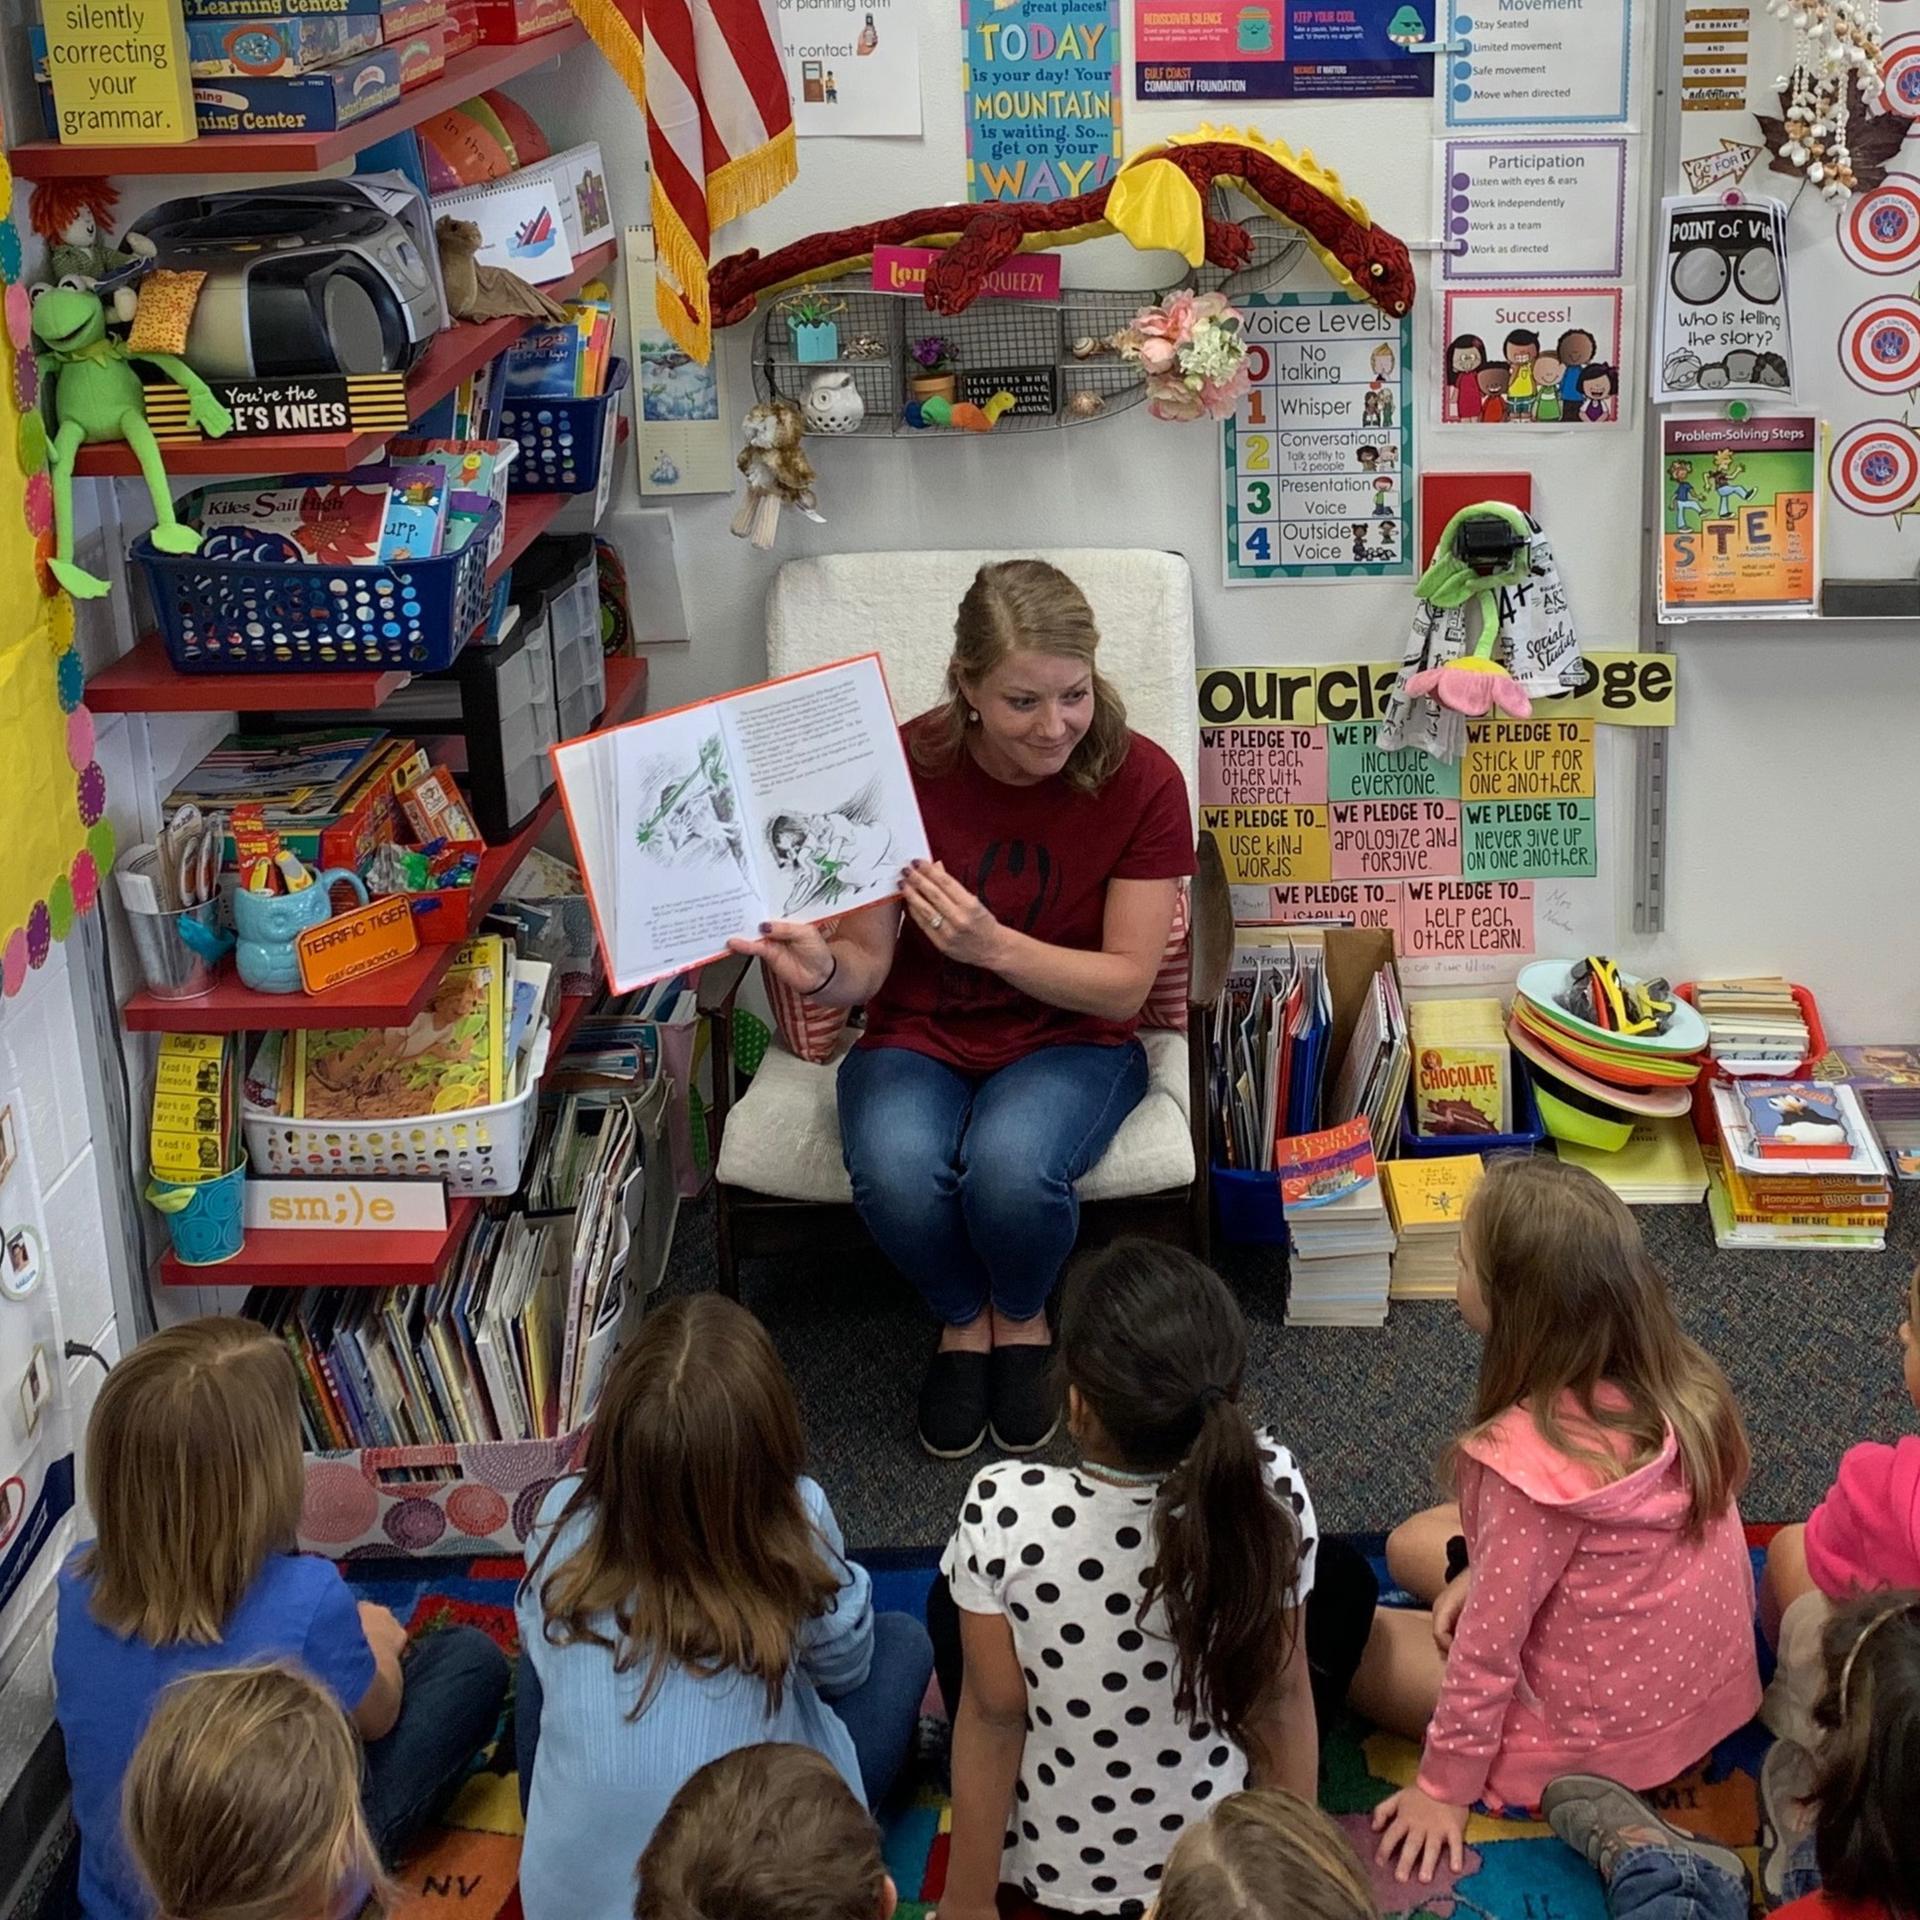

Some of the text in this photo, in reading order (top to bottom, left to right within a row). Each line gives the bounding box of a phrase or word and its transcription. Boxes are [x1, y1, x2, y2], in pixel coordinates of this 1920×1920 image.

[288, 0, 348, 12] Center
[1022, 1, 1057, 17] great
[1499, 0, 1583, 11] Movement
[66, 4, 144, 33] silently
[1474, 19, 1529, 31] Stay Seated
[1709, 21, 1738, 29] BRAVE
[799, 44, 853, 57] contact
[976, 23, 1107, 62] TODAY
[1474, 42, 1562, 52] Limited movement
[53, 38, 168, 69] correcting
[973, 68, 1112, 87] is your day! Your
[1144, 67, 1191, 79] GULF COAST
[1473, 65, 1546, 75] Safe movement
[89, 73, 136, 101] your
[1144, 80, 1246, 92] COMMUNITY FOUNDATION
[1474, 88, 1571, 100] Move when directed
[974, 90, 1111, 120] MOUNTAIN
[63, 107, 170, 135] grammar.
[243, 113, 306, 129] Center
[980, 123, 1108, 143] is waiting. So...
[462, 135, 487, 163] the
[991, 142, 1098, 160] get on your
[1488, 154, 1585, 170] Participation
[1692, 147, 1751, 185] Go FOR IT
[1471, 176, 1577, 187] Listen with eyes & ears
[1470, 198, 1565, 208] Work independently
[1470, 222, 1494, 231] Work
[1518, 222, 1541, 230] team
[1672, 219, 1742, 242] POINT of
[1471, 245, 1497, 254] Work
[1512, 244, 1549, 253] directed
[1242, 311, 1391, 334] Voice Levels
[1495, 306, 1572, 324] Success!
[1678, 310, 1781, 331] Who is telling
[1688, 330, 1773, 348] the story?
[1300, 345, 1327, 362] No
[1281, 363, 1341, 383] talking
[225, 385, 318, 405] You're the
[967, 387, 991, 395] LOVE
[275, 403, 347, 429] KNEES
[1247, 390, 1266, 424] 1
[1280, 398, 1352, 418] Whisper
[1280, 431, 1391, 447] Conversational
[1675, 428, 1804, 442] Problem-Solving Steps
[1246, 435, 1270, 470] 2
[1287, 451, 1345, 462] Talk softly to
[1292, 461, 1345, 472] 1-2 people
[1281, 478, 1371, 494] Presentation
[208, 501, 250, 515] Kites
[252, 493, 297, 517] Sail
[1247, 482, 1271, 515] 3
[1304, 501, 1347, 515] Voice
[384, 521, 419, 542] urp.
[1282, 523, 1351, 541] Outside
[1245, 527, 1271, 560] 4
[1293, 544, 1342, 560] Voice
[1199, 671, 1311, 723] our
[1201, 730, 1285, 749] WE PLEDGE
[1467, 724, 1551, 743] WE PLEDGE
[1205, 809, 1288, 828] WE PLEDGE
[1333, 803, 1418, 823] WE PLEDGE
[1467, 804, 1551, 824] WE PLEDGE
[1275, 885, 1359, 904] WE PLEDGE
[1408, 881, 1492, 900] WE PLEDGE
[304, 904, 408, 957] TERRIFIC TIGER
[367, 948, 400, 968] SCHOOL
[1420, 1065, 1497, 1090] CHOCOLATE
[421, 1874, 482, 1898] NV
